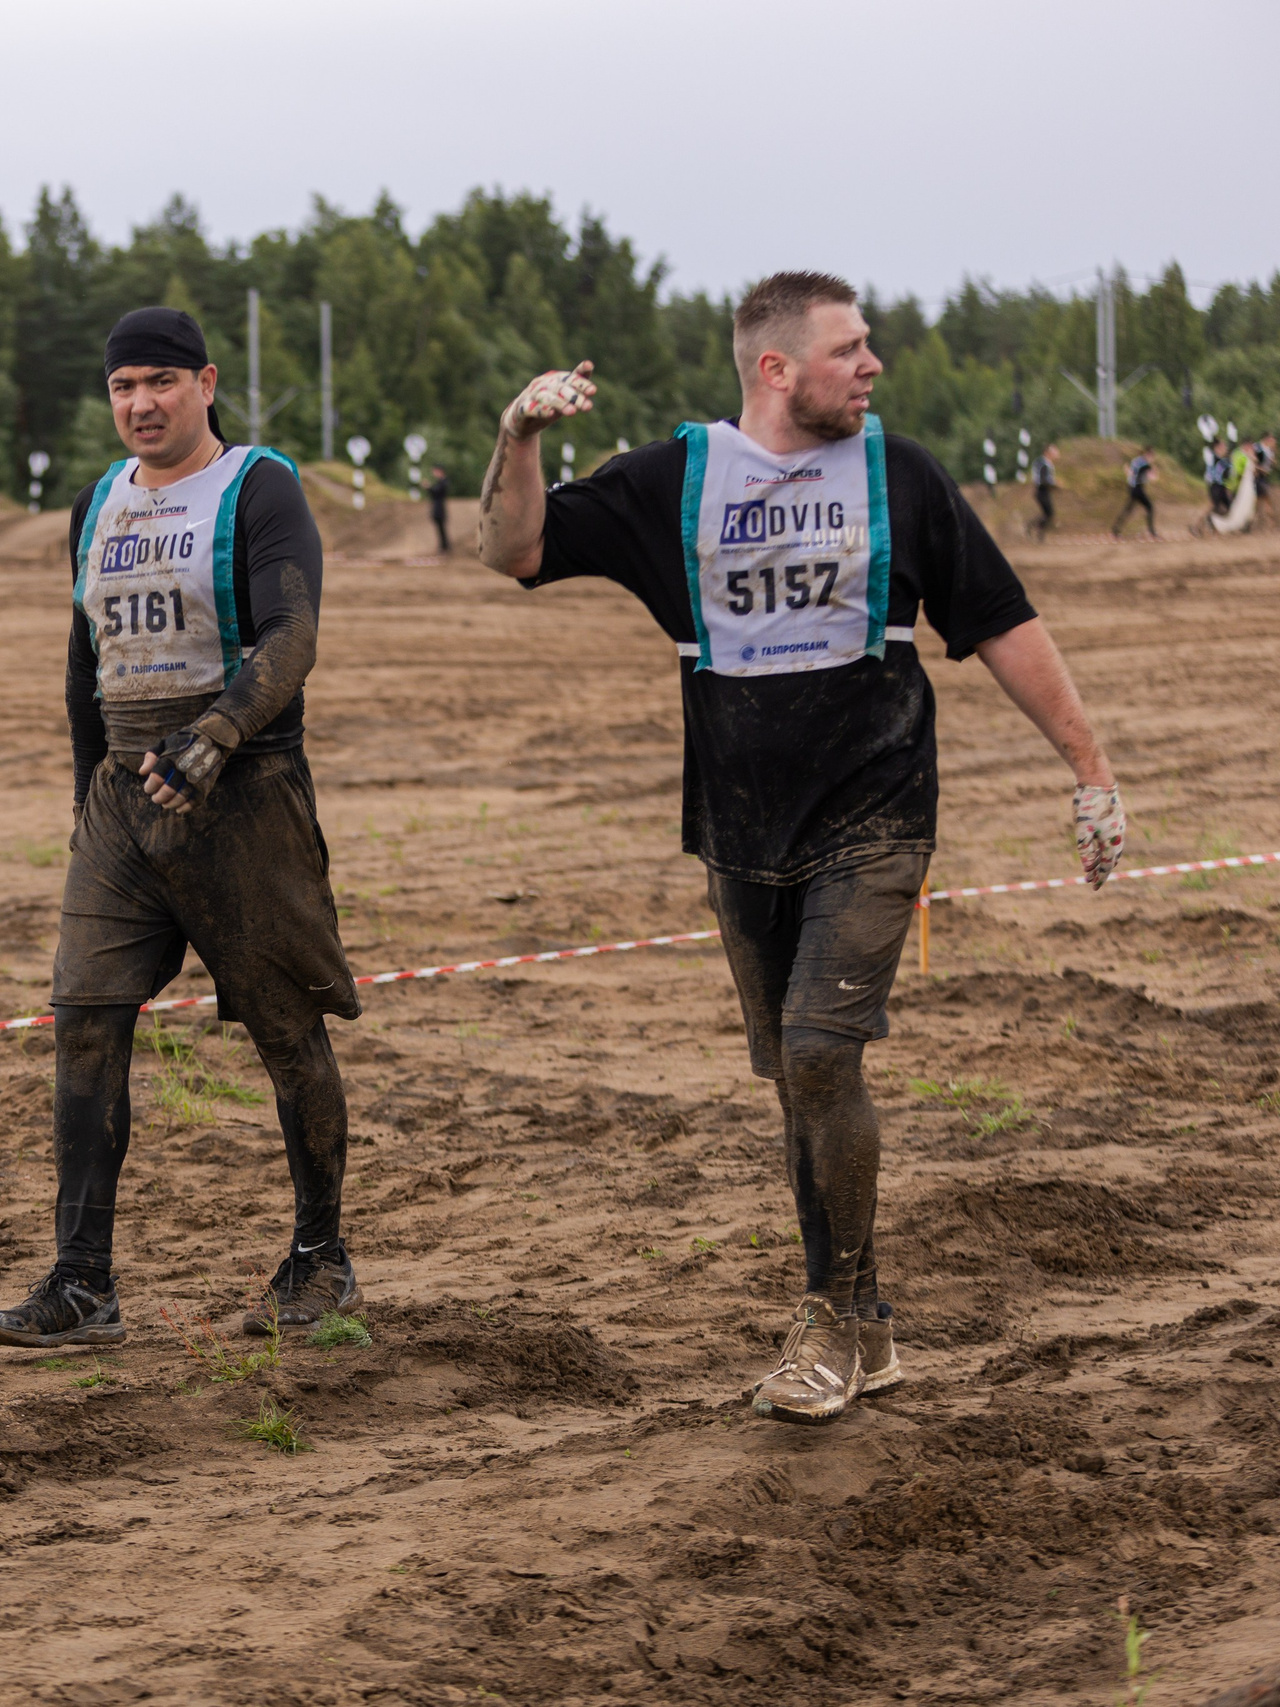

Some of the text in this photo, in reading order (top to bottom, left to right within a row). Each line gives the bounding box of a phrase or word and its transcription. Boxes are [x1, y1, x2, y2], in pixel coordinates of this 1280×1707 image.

[126, 505, 188, 519] ГОНКА ГЕРОЕВ
[723, 502, 844, 540] RODVIG
[103, 531, 194, 569] RODVIG
[727, 562, 839, 616] 5157
[104, 588, 186, 637] 5161
[761, 640, 829, 657] ГАЗПРОМБАНК
[131, 661, 187, 675] ГАЗПРОМБАНК
